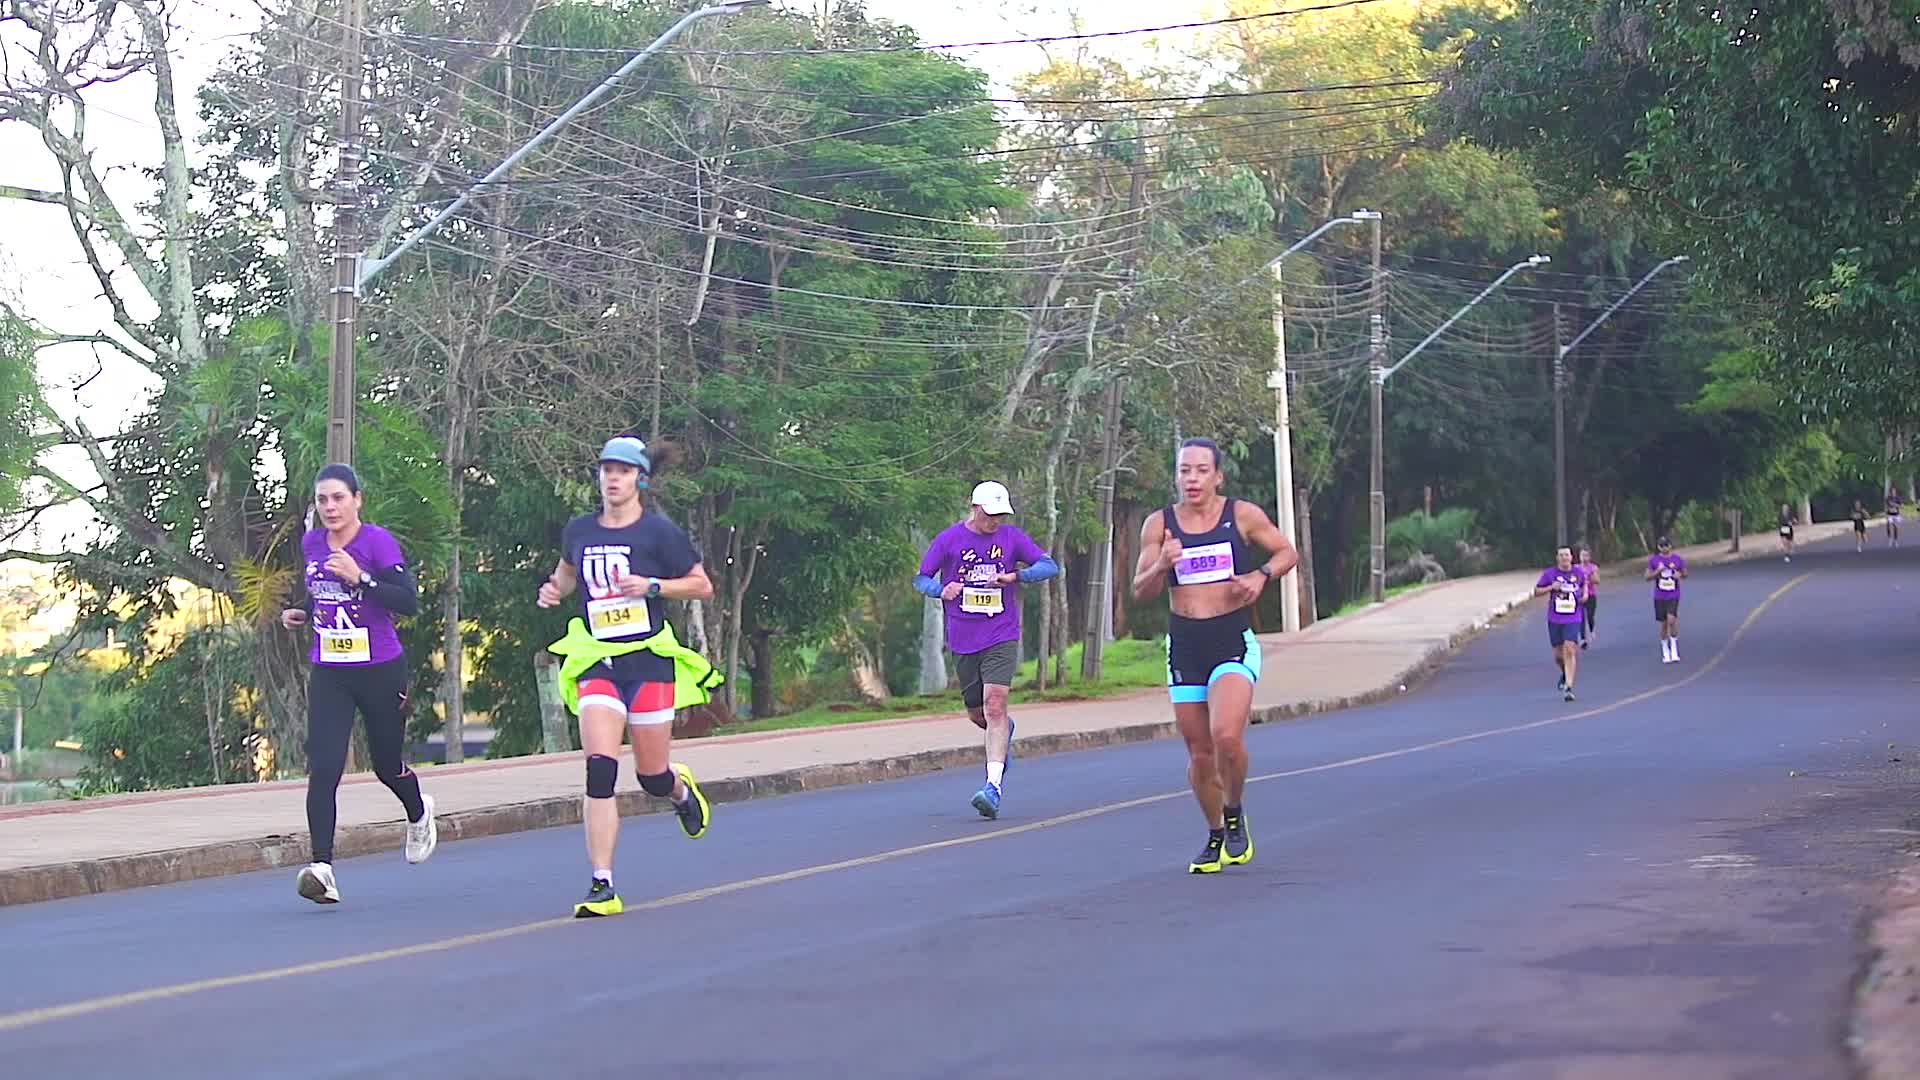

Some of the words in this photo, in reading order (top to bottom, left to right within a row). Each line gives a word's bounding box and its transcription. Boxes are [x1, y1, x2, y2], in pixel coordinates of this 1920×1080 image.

[1191, 555, 1217, 569] 689
[975, 594, 992, 604] 119
[604, 608, 631, 623] 134
[331, 638, 353, 650] 149
